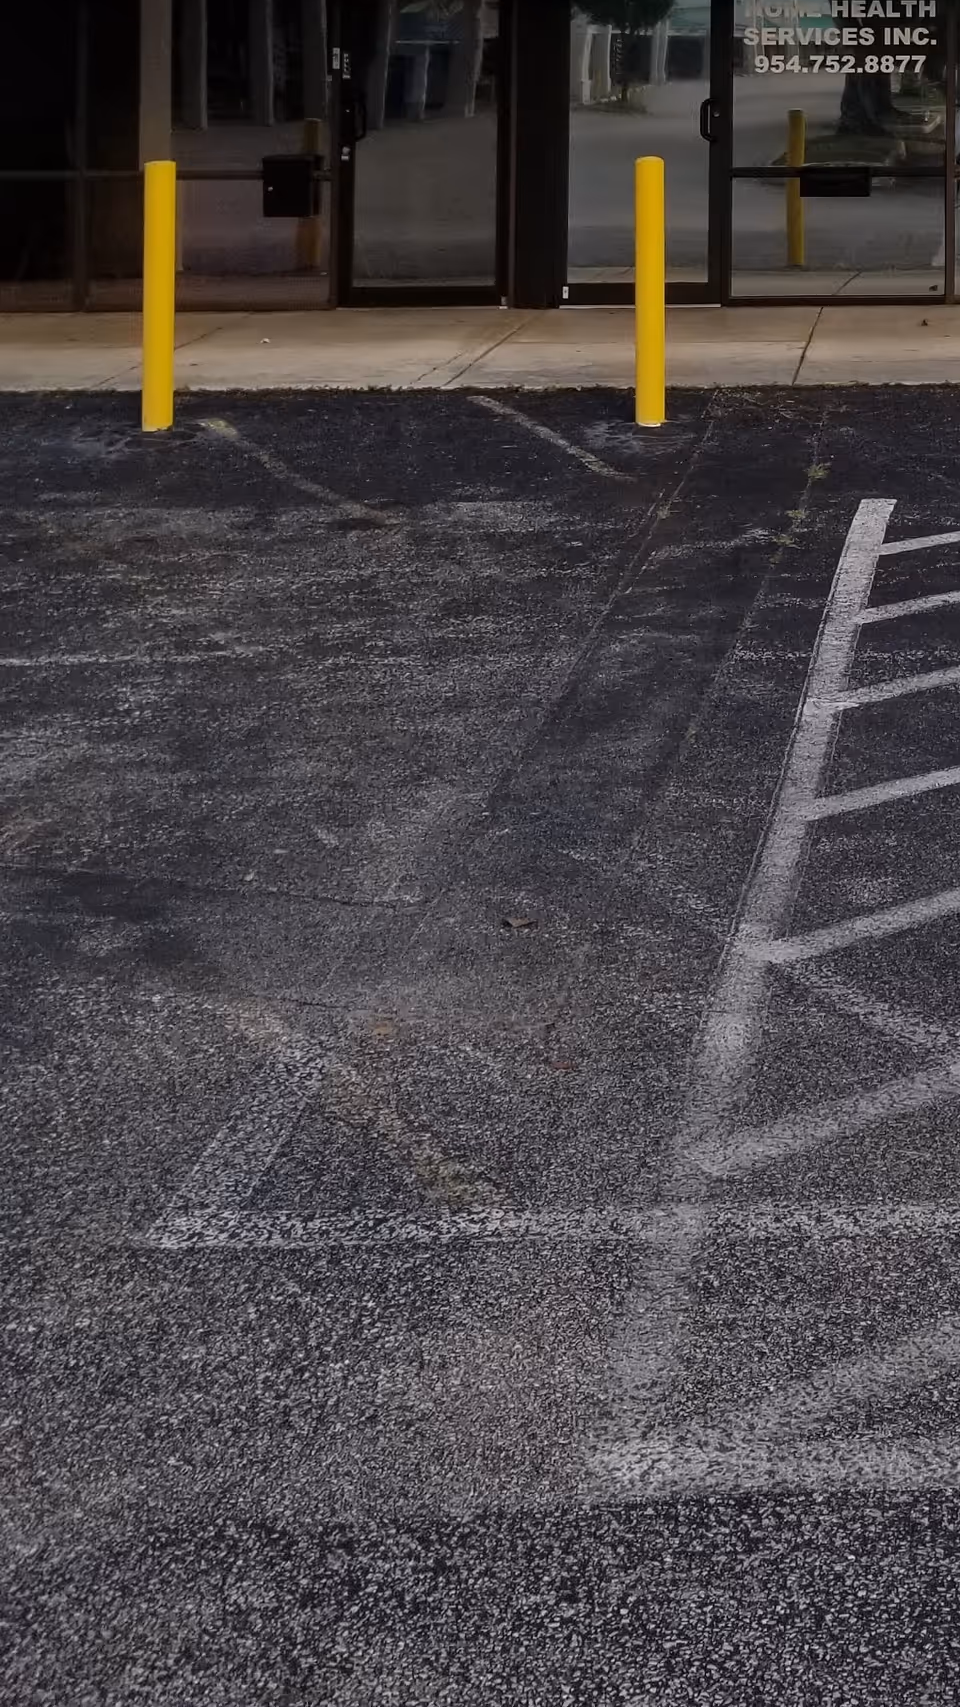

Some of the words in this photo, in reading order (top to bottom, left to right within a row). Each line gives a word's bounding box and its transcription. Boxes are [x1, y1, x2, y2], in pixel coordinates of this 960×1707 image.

[831, 0, 936, 18] HEALTH
[743, 27, 875, 46] SERVICES
[884, 27, 937, 46] INC.
[754, 55, 927, 74] 954.752.8877
